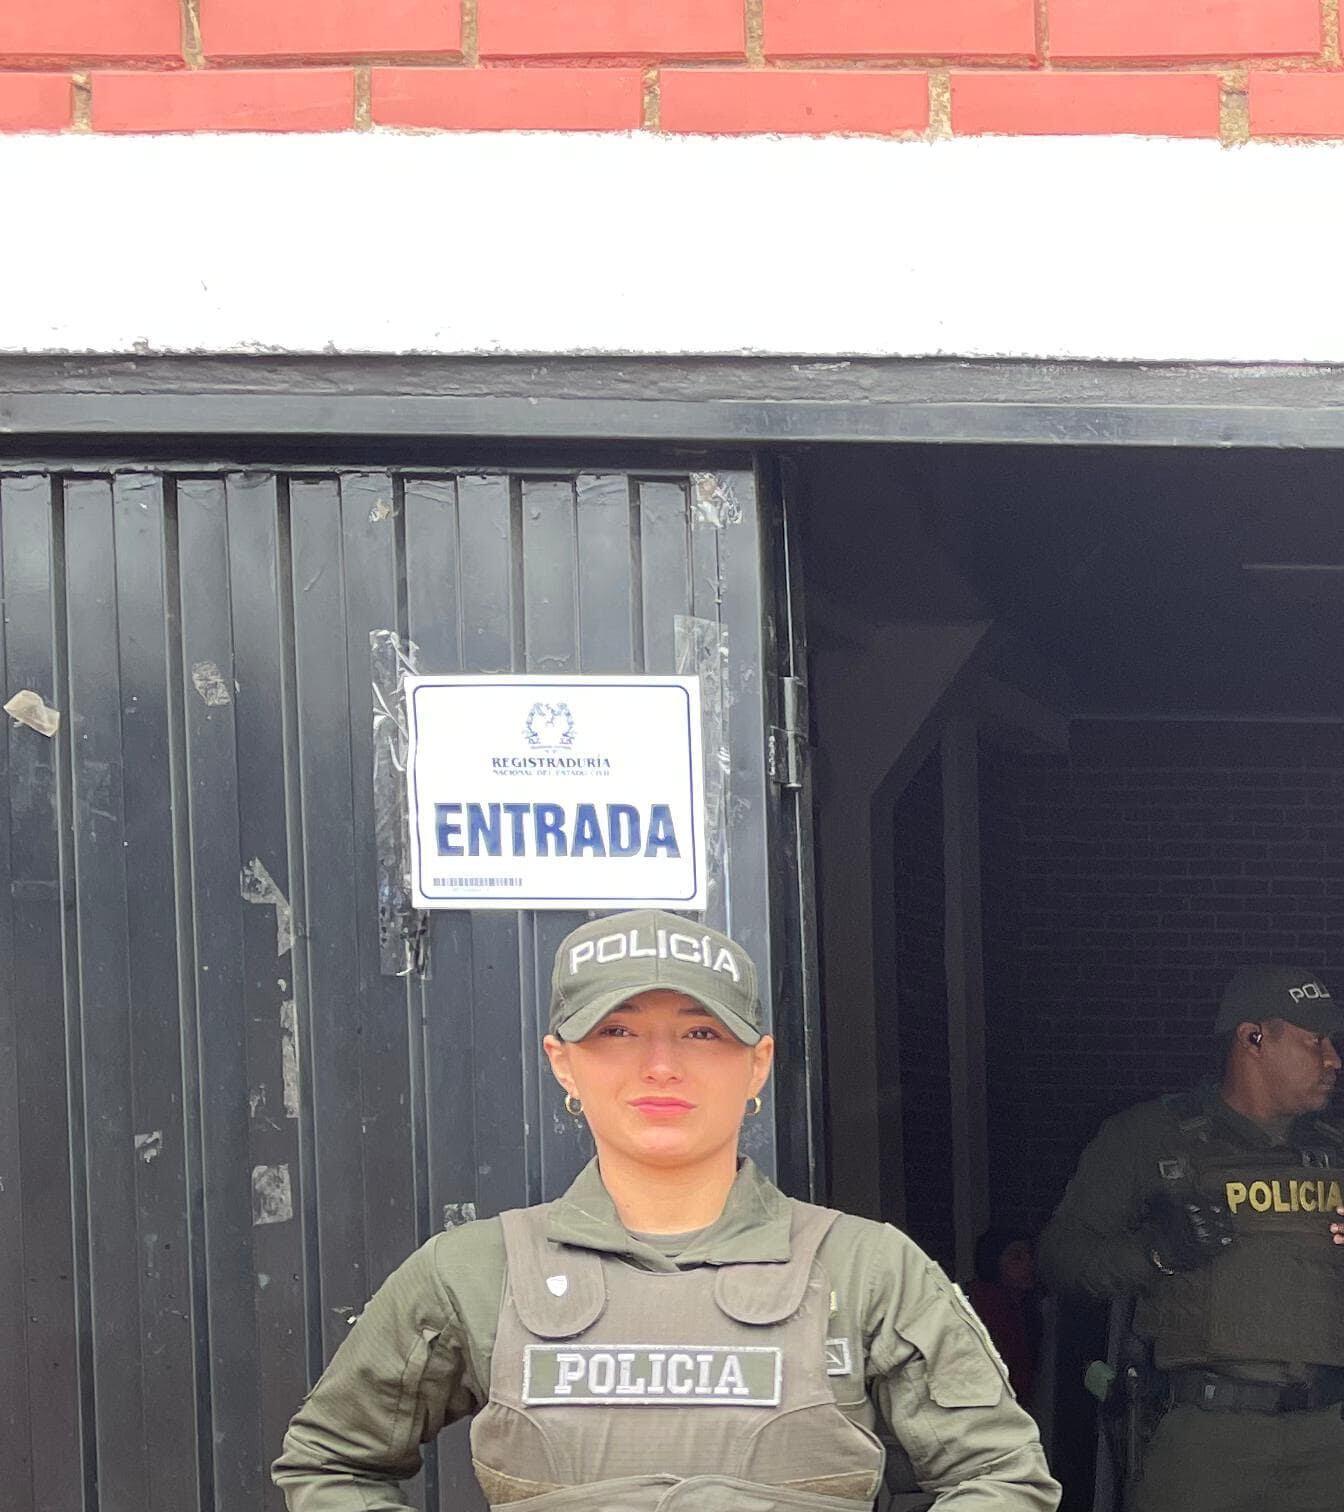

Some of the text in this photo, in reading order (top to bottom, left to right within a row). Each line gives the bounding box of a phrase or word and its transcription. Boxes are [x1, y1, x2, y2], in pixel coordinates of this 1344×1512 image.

[491, 754, 612, 769] REGISTRADURÍA
[433, 802, 682, 859] ENTRADA
[569, 929, 741, 983] POLICÍA
[1225, 1180, 1344, 1215] POLICIA
[553, 1353, 750, 1396] POLICIA
